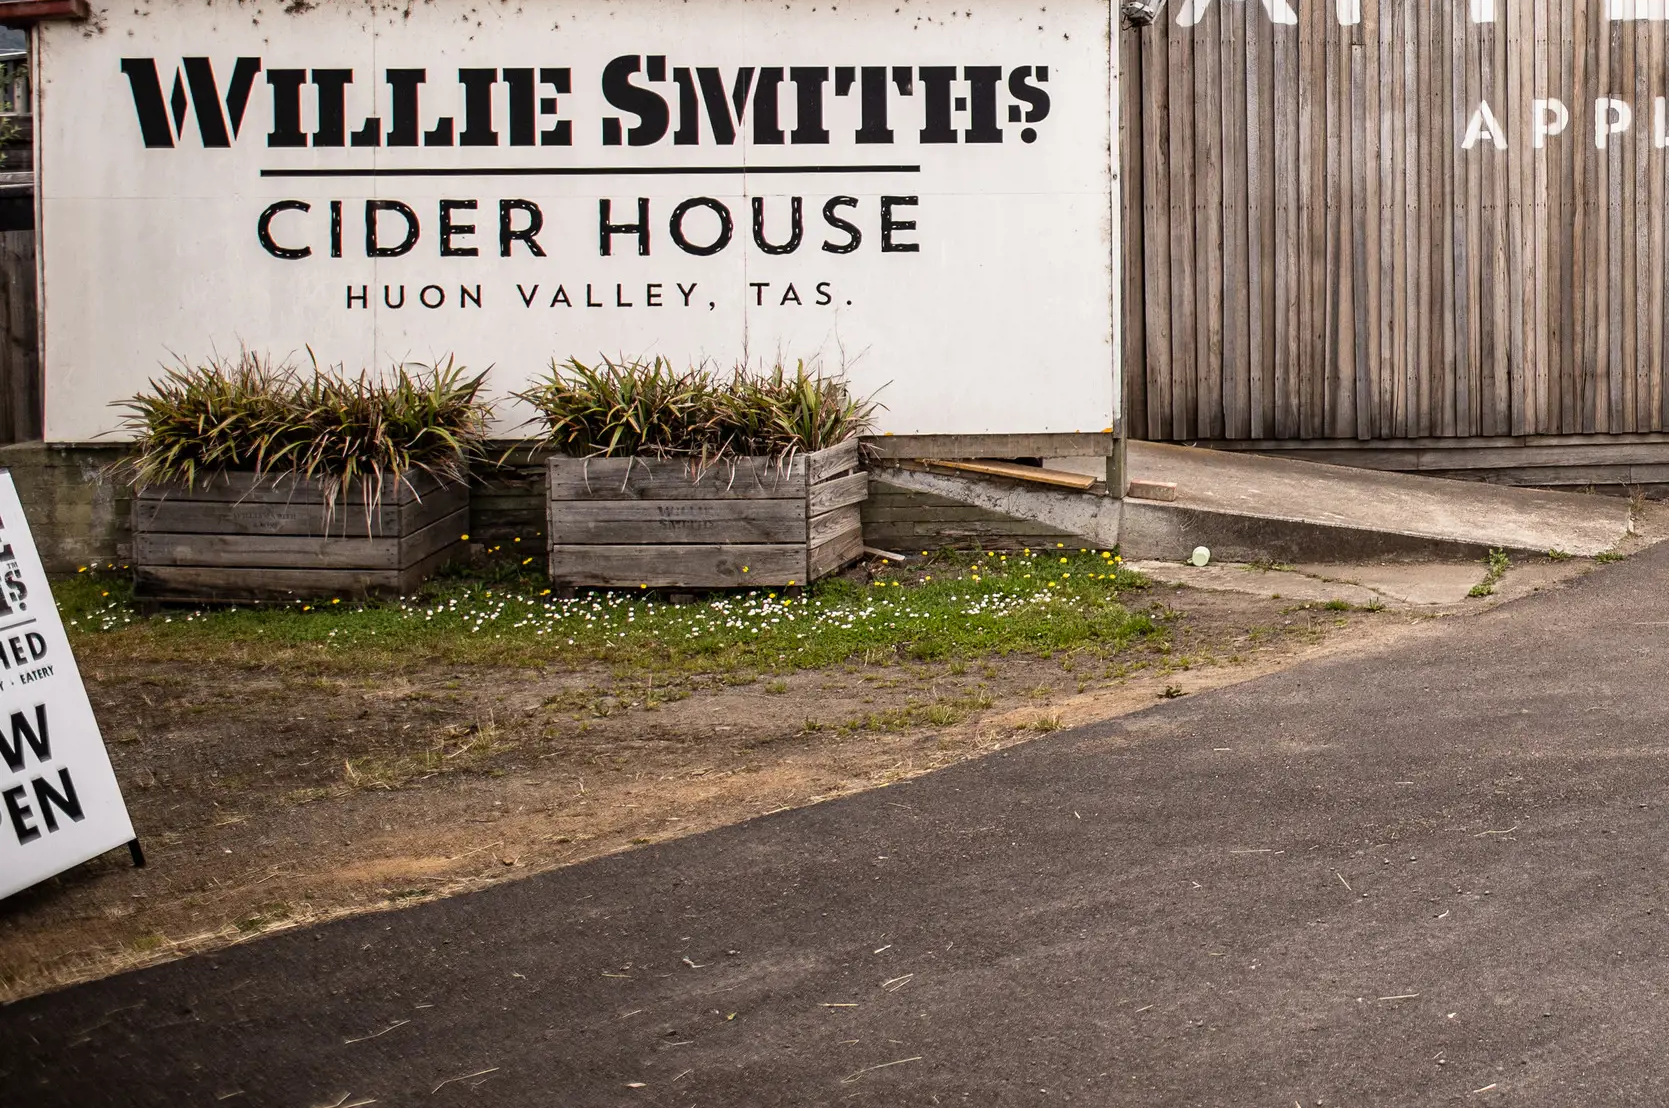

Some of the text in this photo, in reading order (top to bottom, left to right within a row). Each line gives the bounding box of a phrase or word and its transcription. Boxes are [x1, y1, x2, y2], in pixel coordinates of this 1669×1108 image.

[120, 56, 573, 148] WILLIE
[257, 195, 920, 260] CIDER HOUSE
[346, 281, 853, 311] HUON VALLEY, TAS.
[20, 665, 54, 685] EATERY
